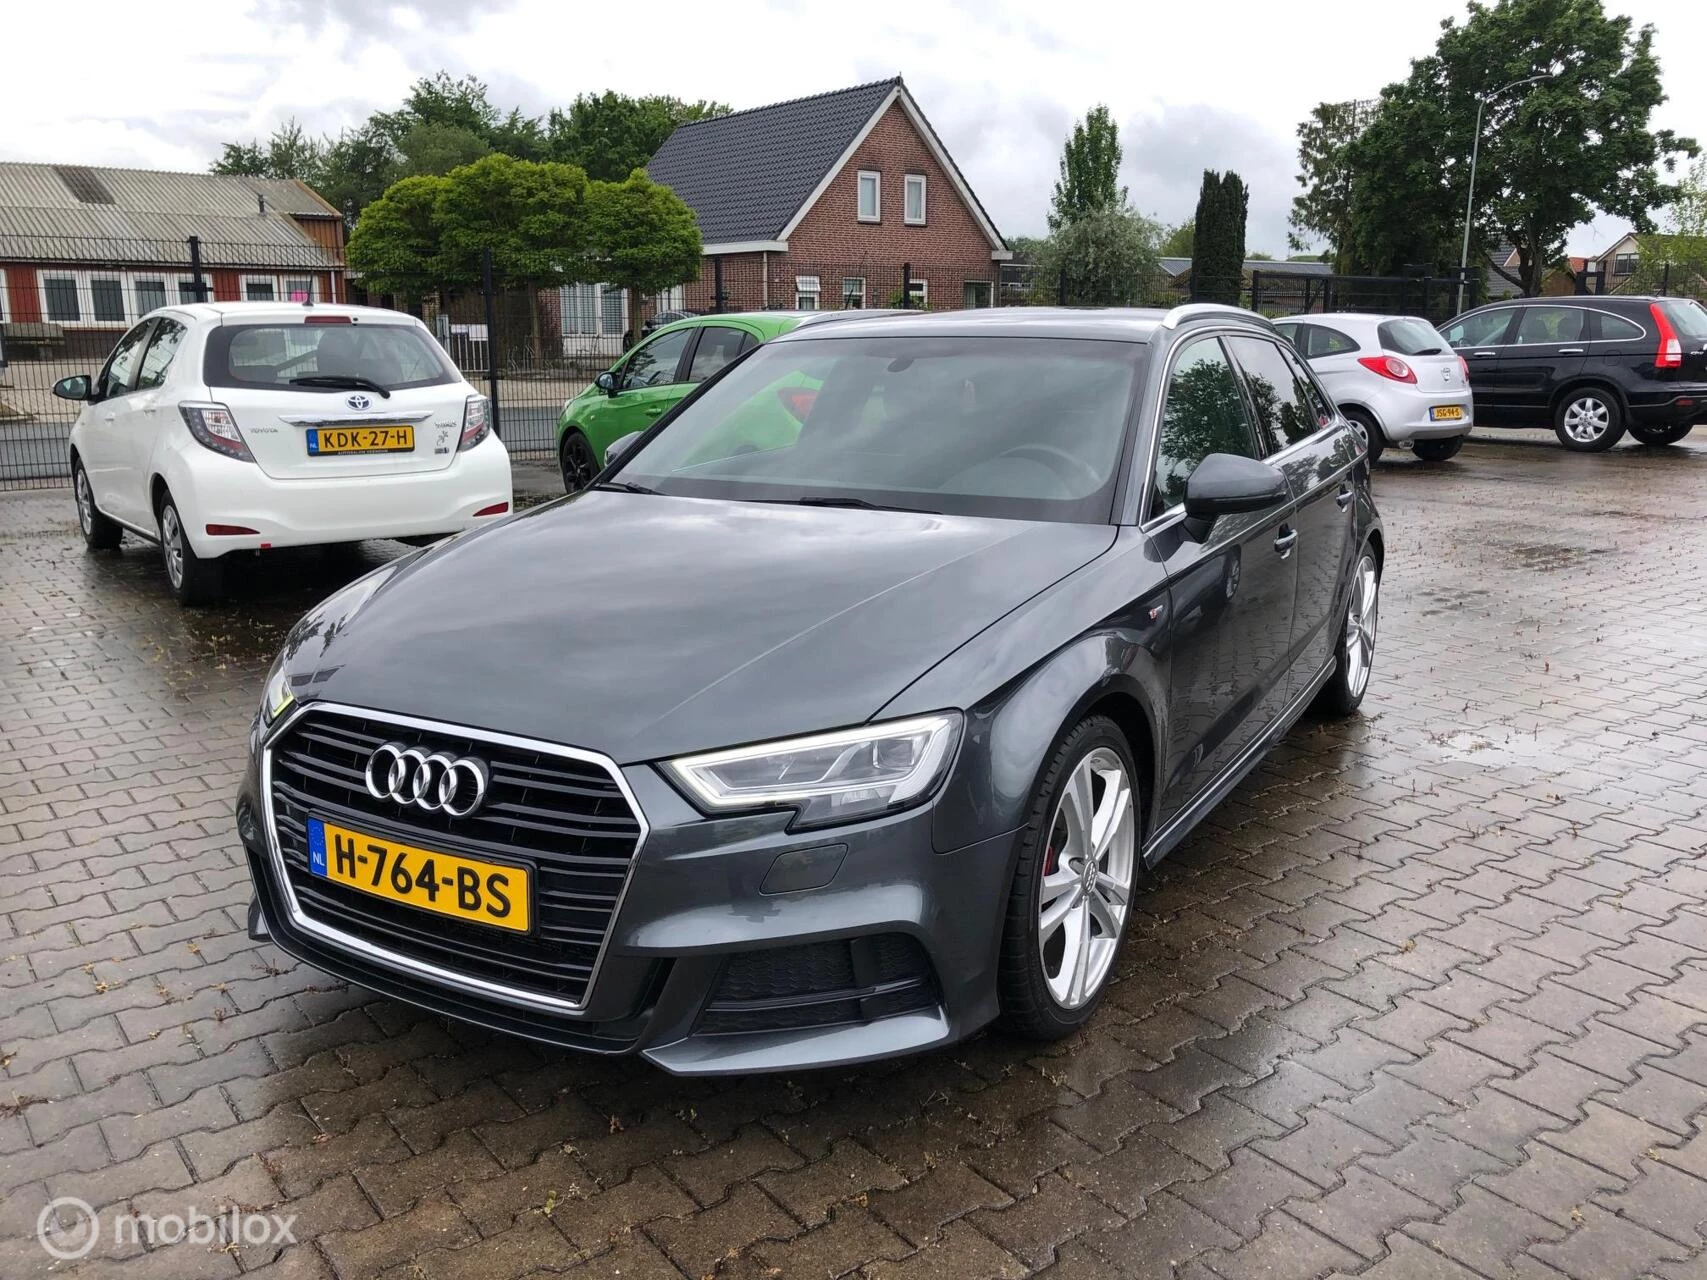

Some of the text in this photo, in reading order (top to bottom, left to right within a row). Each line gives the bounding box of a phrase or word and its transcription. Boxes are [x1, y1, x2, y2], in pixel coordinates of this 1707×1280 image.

[324, 430, 408, 449] KDK-27-H
[312, 834, 512, 918] NL H-764-BS
